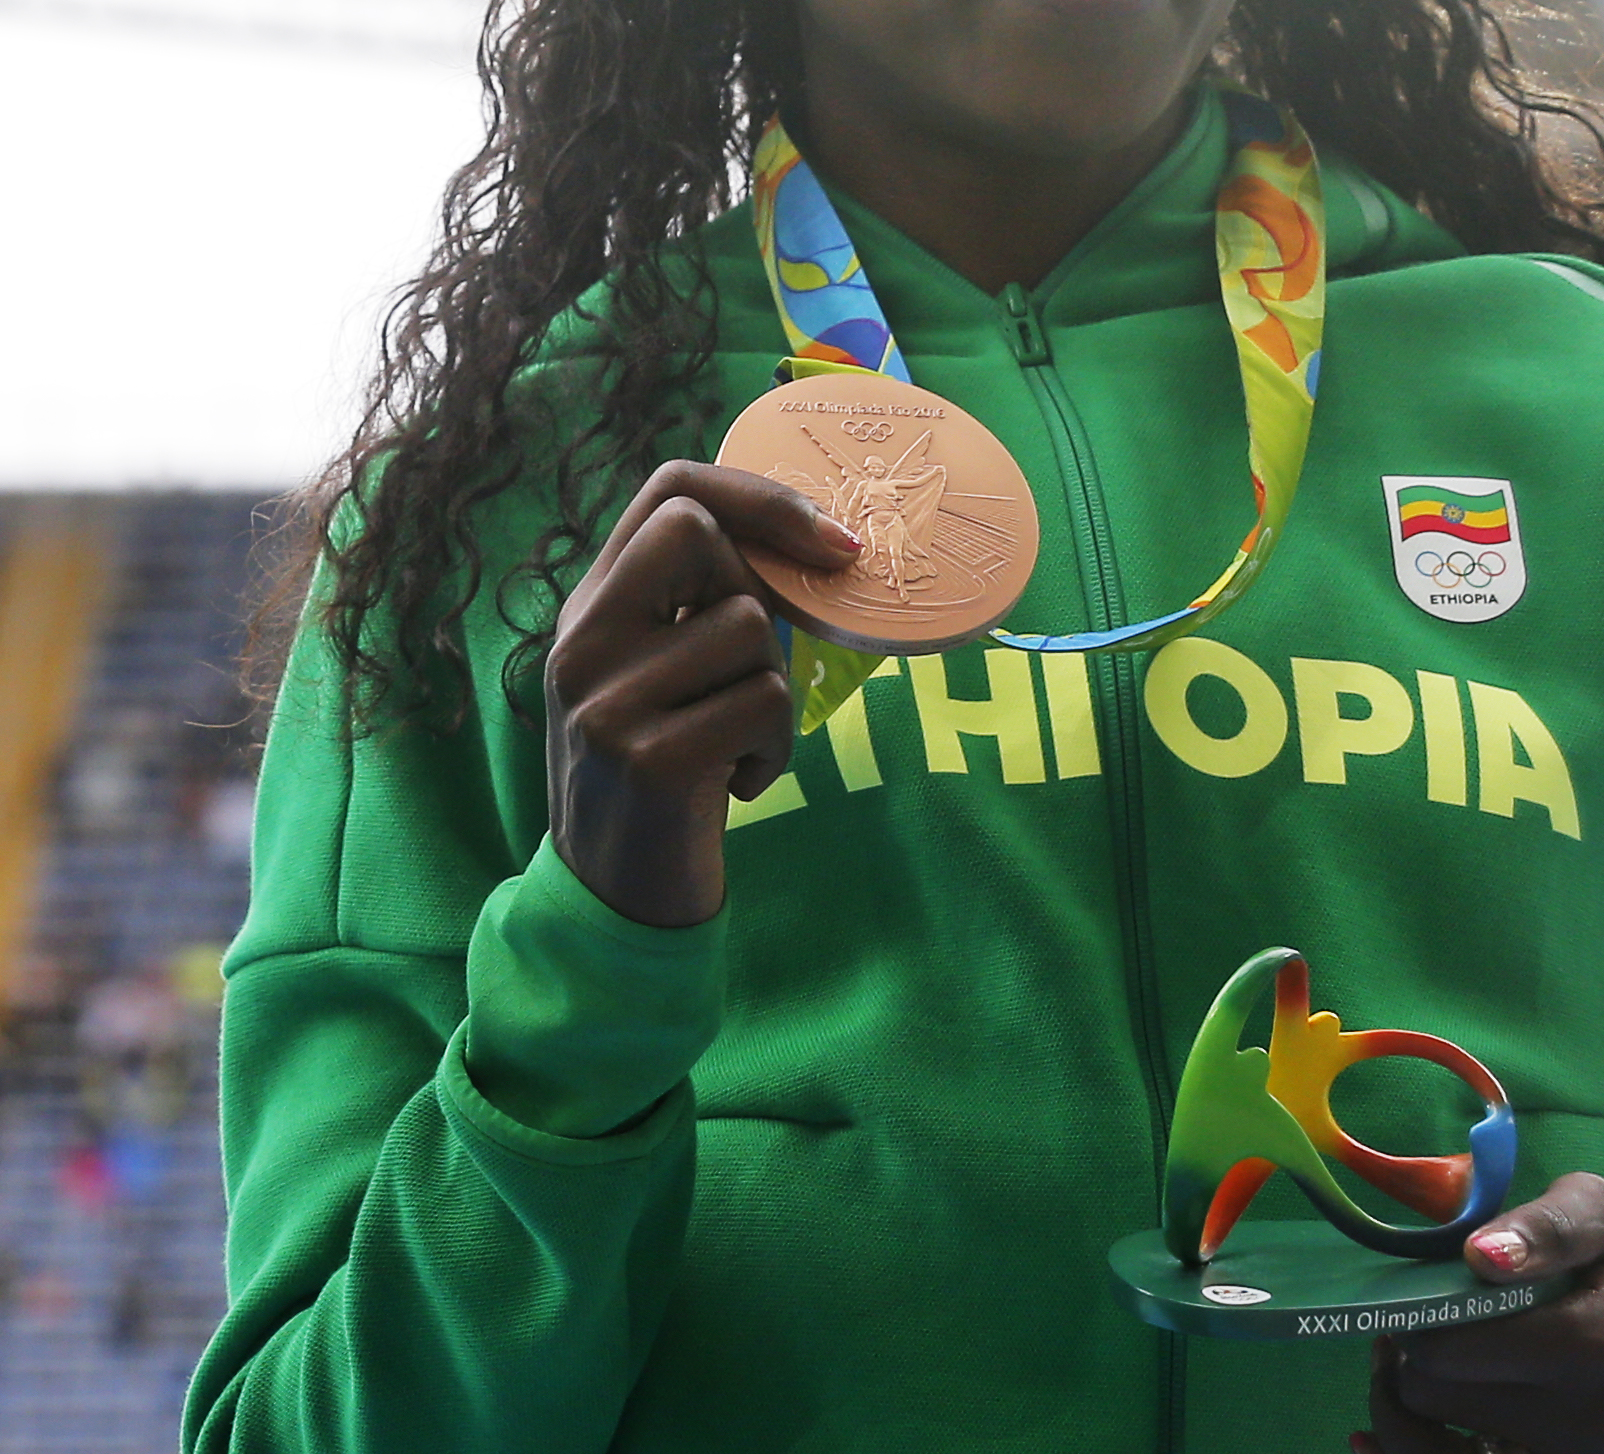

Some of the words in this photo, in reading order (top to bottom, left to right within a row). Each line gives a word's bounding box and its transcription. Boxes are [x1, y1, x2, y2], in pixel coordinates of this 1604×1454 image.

[888, 404, 911, 417] Rio
[913, 406, 946, 419] 2016
[1429, 593, 1499, 606] ETHIOPIA
[1297, 1313, 1349, 1335] XXXI
[1356, 1304, 1460, 1331] Olimpíada
[1466, 1296, 1493, 1317] Rio
[1498, 1286, 1534, 1311] 2016
